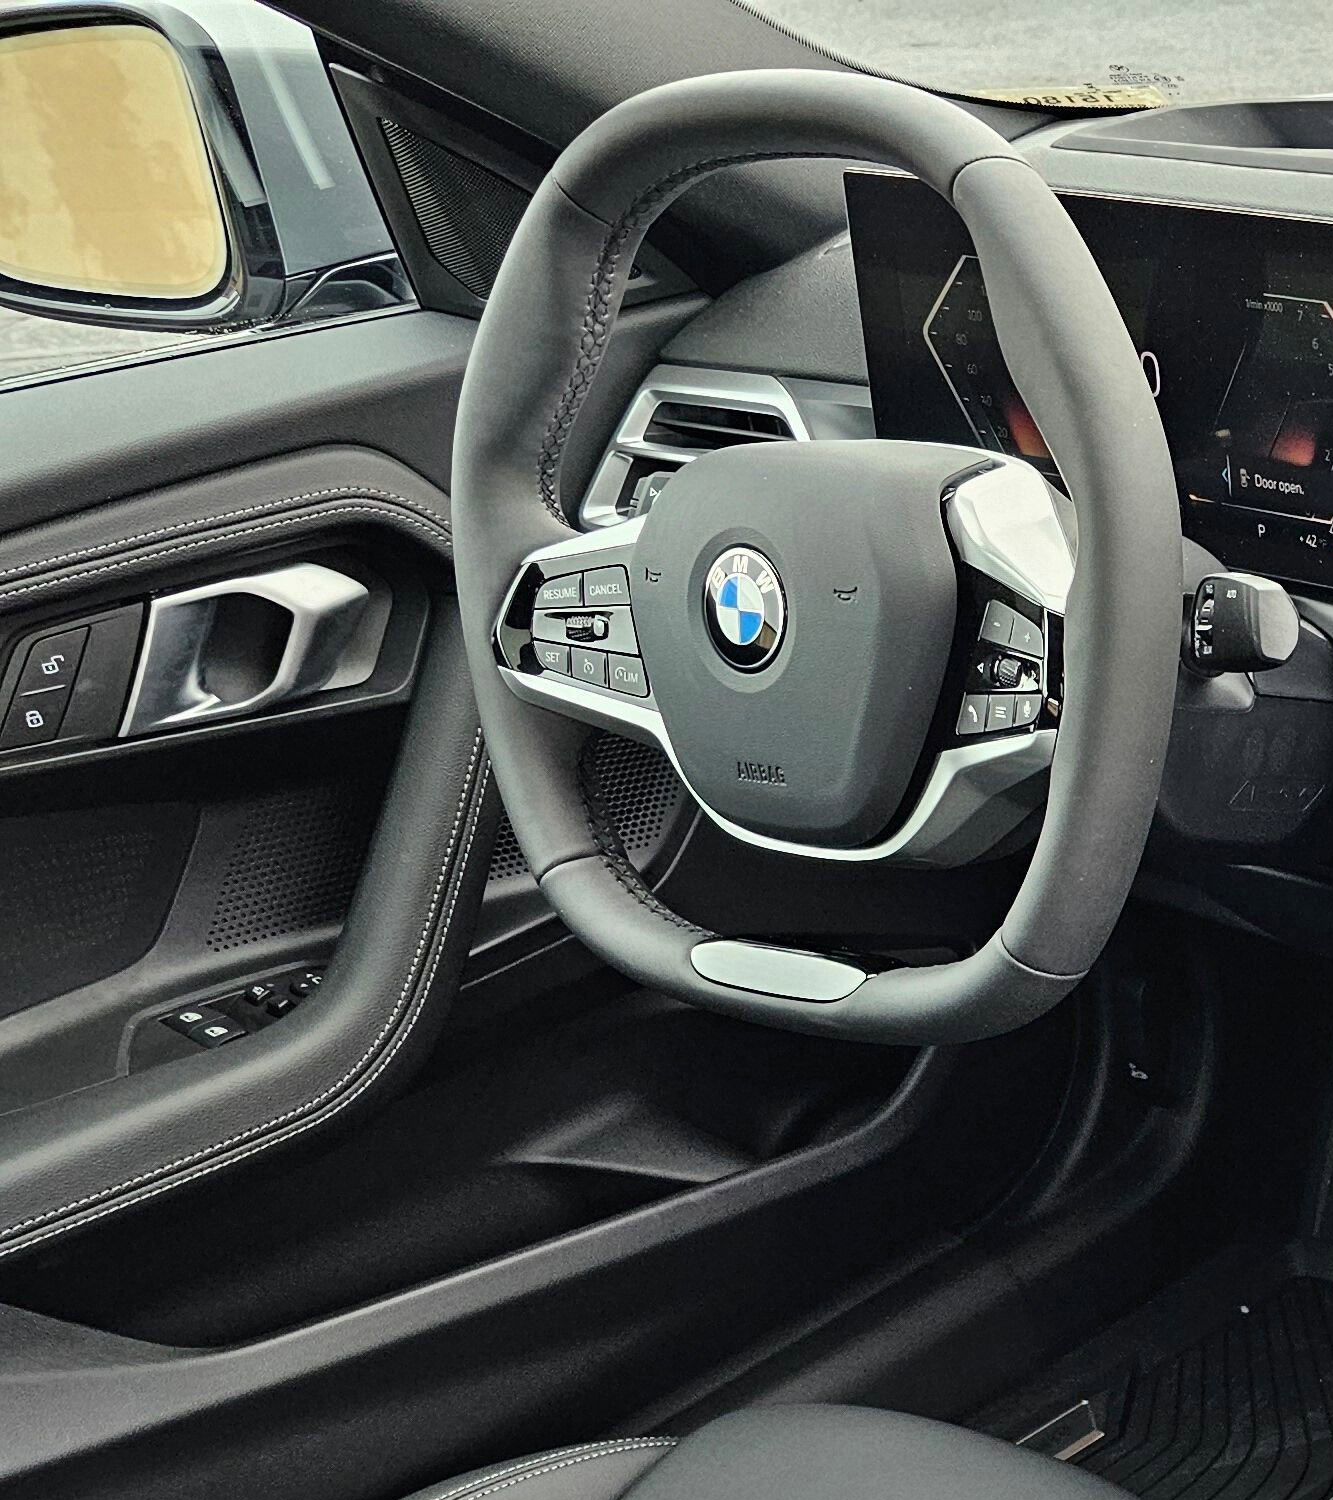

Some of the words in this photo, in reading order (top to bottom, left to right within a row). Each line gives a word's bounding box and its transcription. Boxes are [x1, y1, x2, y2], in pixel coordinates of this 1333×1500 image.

[968, 309, 983, 322] 100
[1297, 310, 1303, 321] 7
[1312, 338, 1319, 350] 6
[1328, 364, 1333, 376] 5
[1324, 450, 1331, 462] 2
[1254, 474, 1277, 490] Door
[1278, 481, 1305, 496] open.
[1257, 524, 1266, 537] P
[711, 555, 775, 594] BMW
[543, 587, 577, 600] RESUME
[589, 583, 622, 597] CANCEL
[545, 652, 560, 663] SET
[623, 671, 638, 683] LIM
[736, 761, 787, 786] AIRBAG
